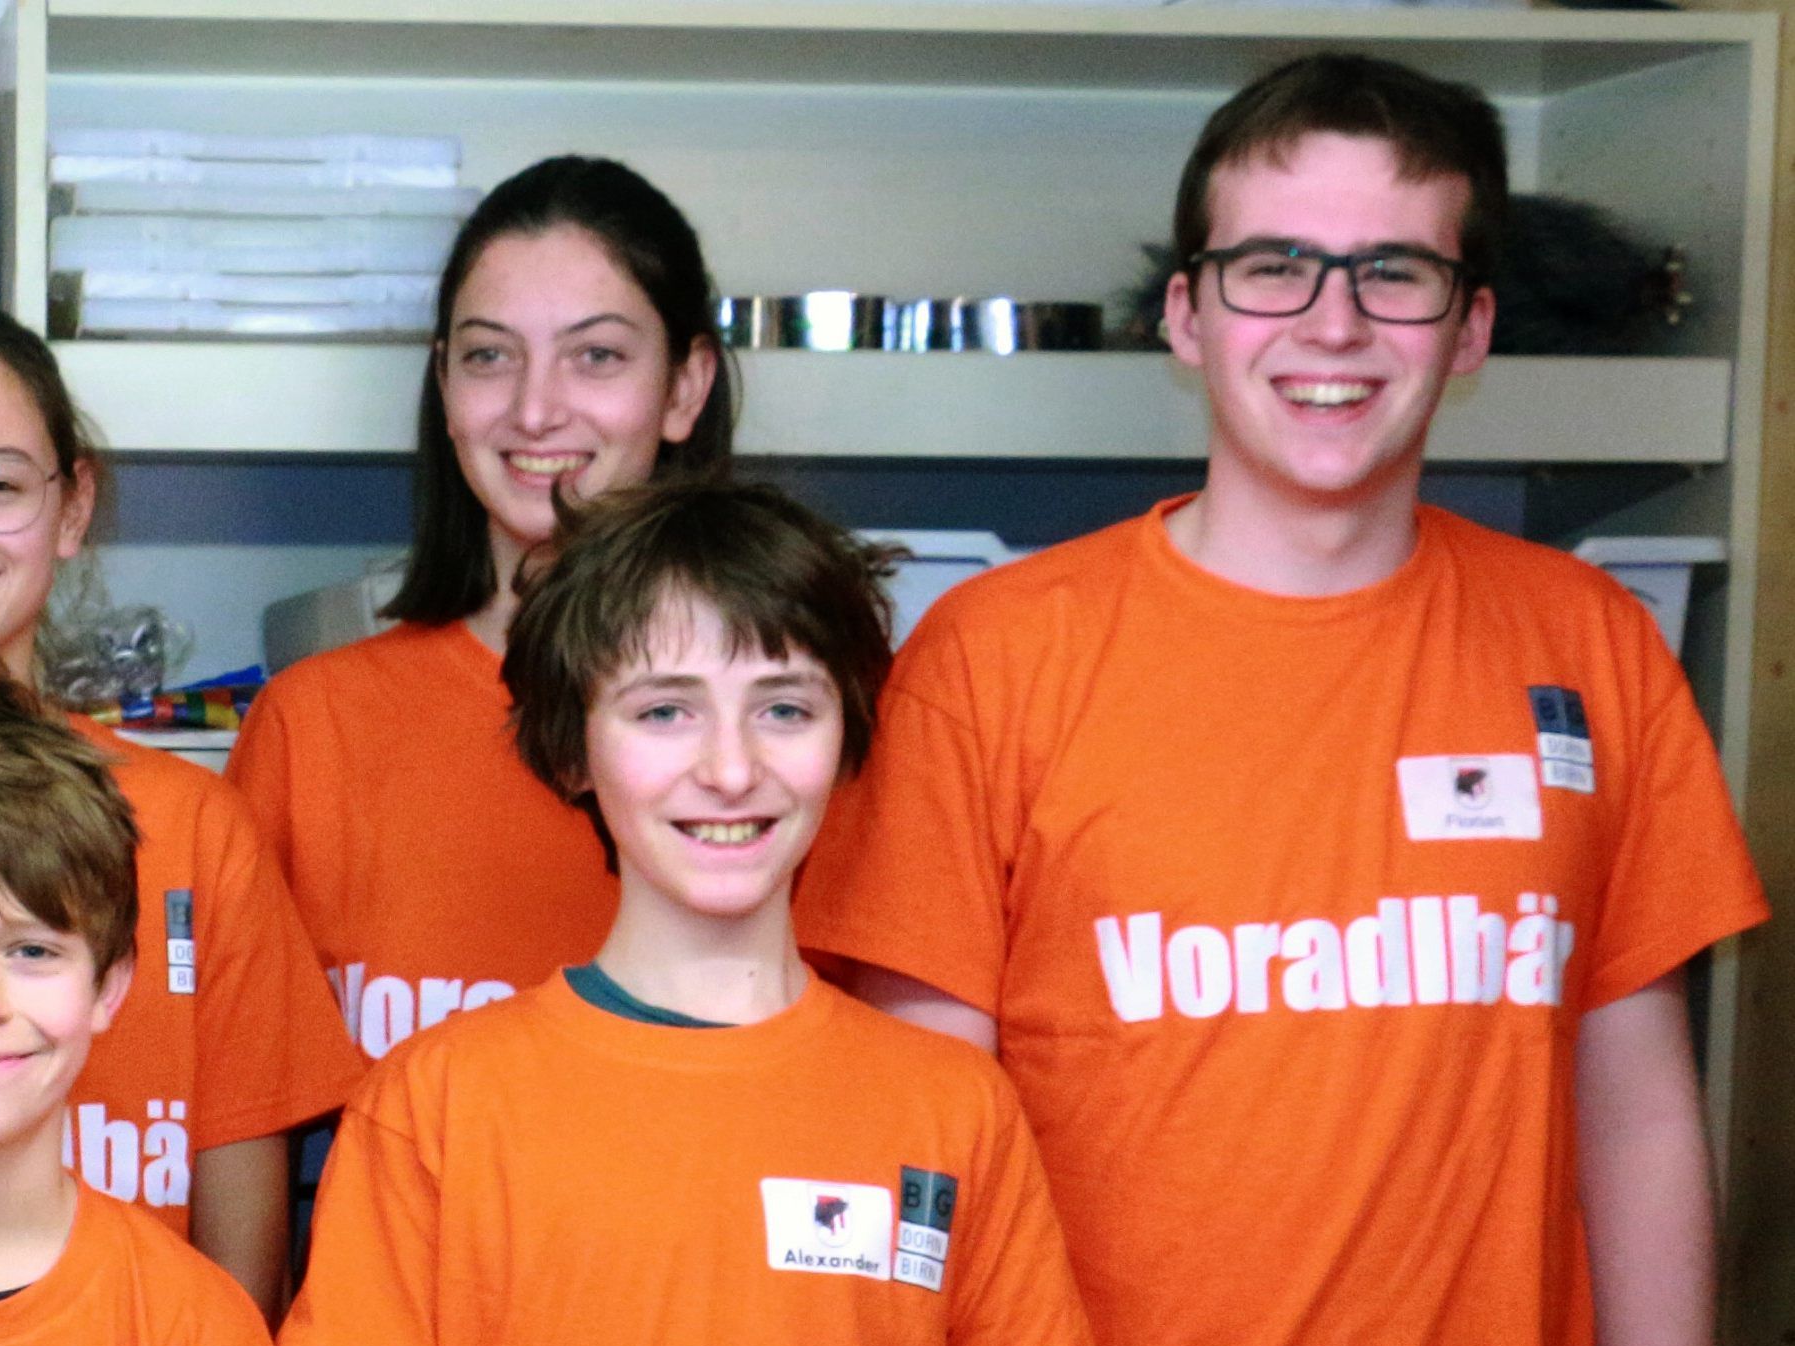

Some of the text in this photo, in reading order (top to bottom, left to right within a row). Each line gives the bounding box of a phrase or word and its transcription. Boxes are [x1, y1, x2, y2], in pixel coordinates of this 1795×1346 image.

[901, 1228, 943, 1256] DORN
[784, 1249, 880, 1274] Alexander
[900, 1256, 938, 1283] BIRN
